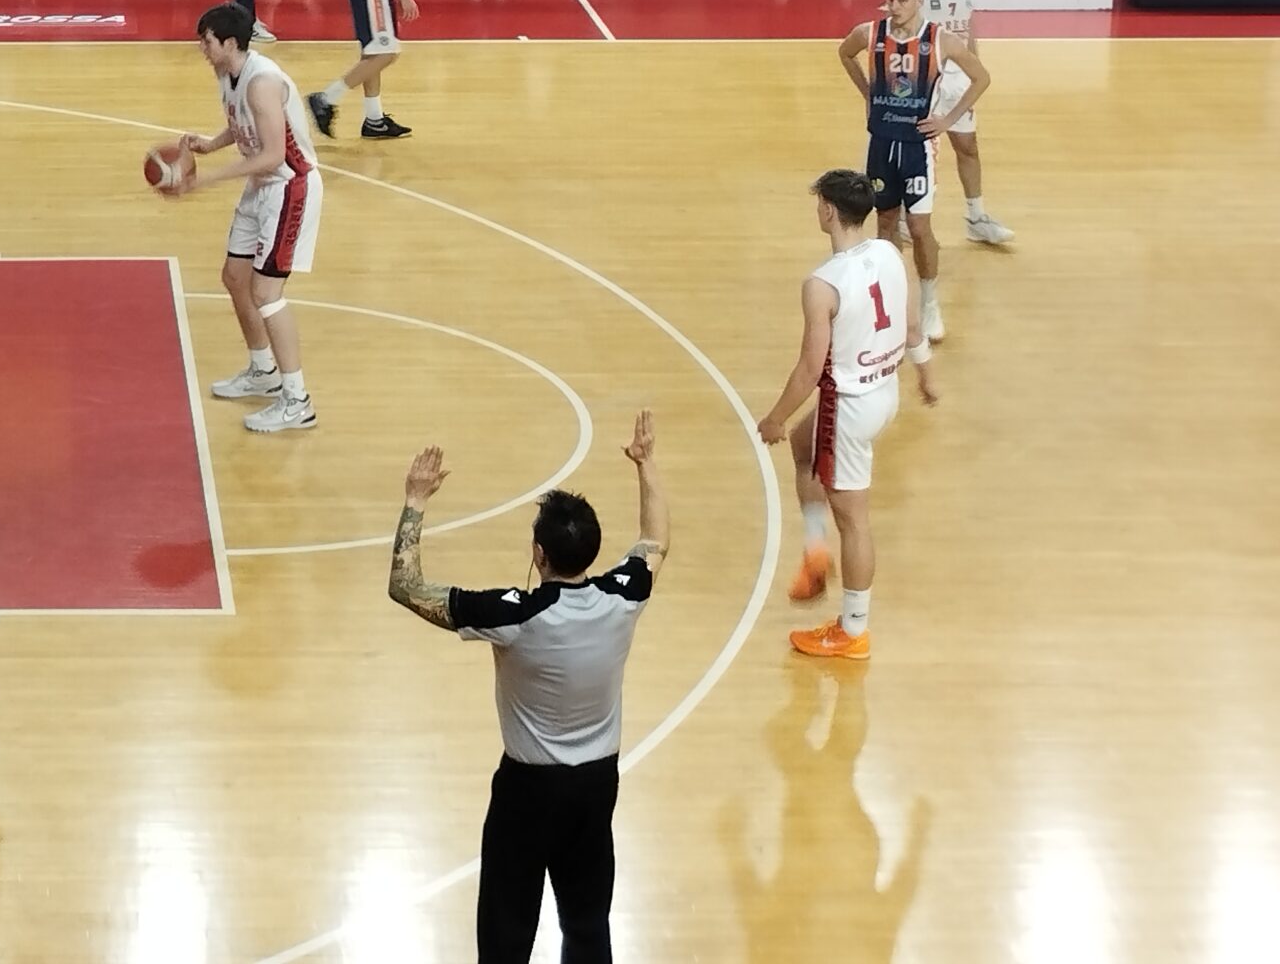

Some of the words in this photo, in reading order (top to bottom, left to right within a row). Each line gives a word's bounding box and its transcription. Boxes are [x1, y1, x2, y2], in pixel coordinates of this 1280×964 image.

[948, 2, 957, 16] 7
[889, 53, 914, 73] 20
[869, 281, 891, 332] 1
